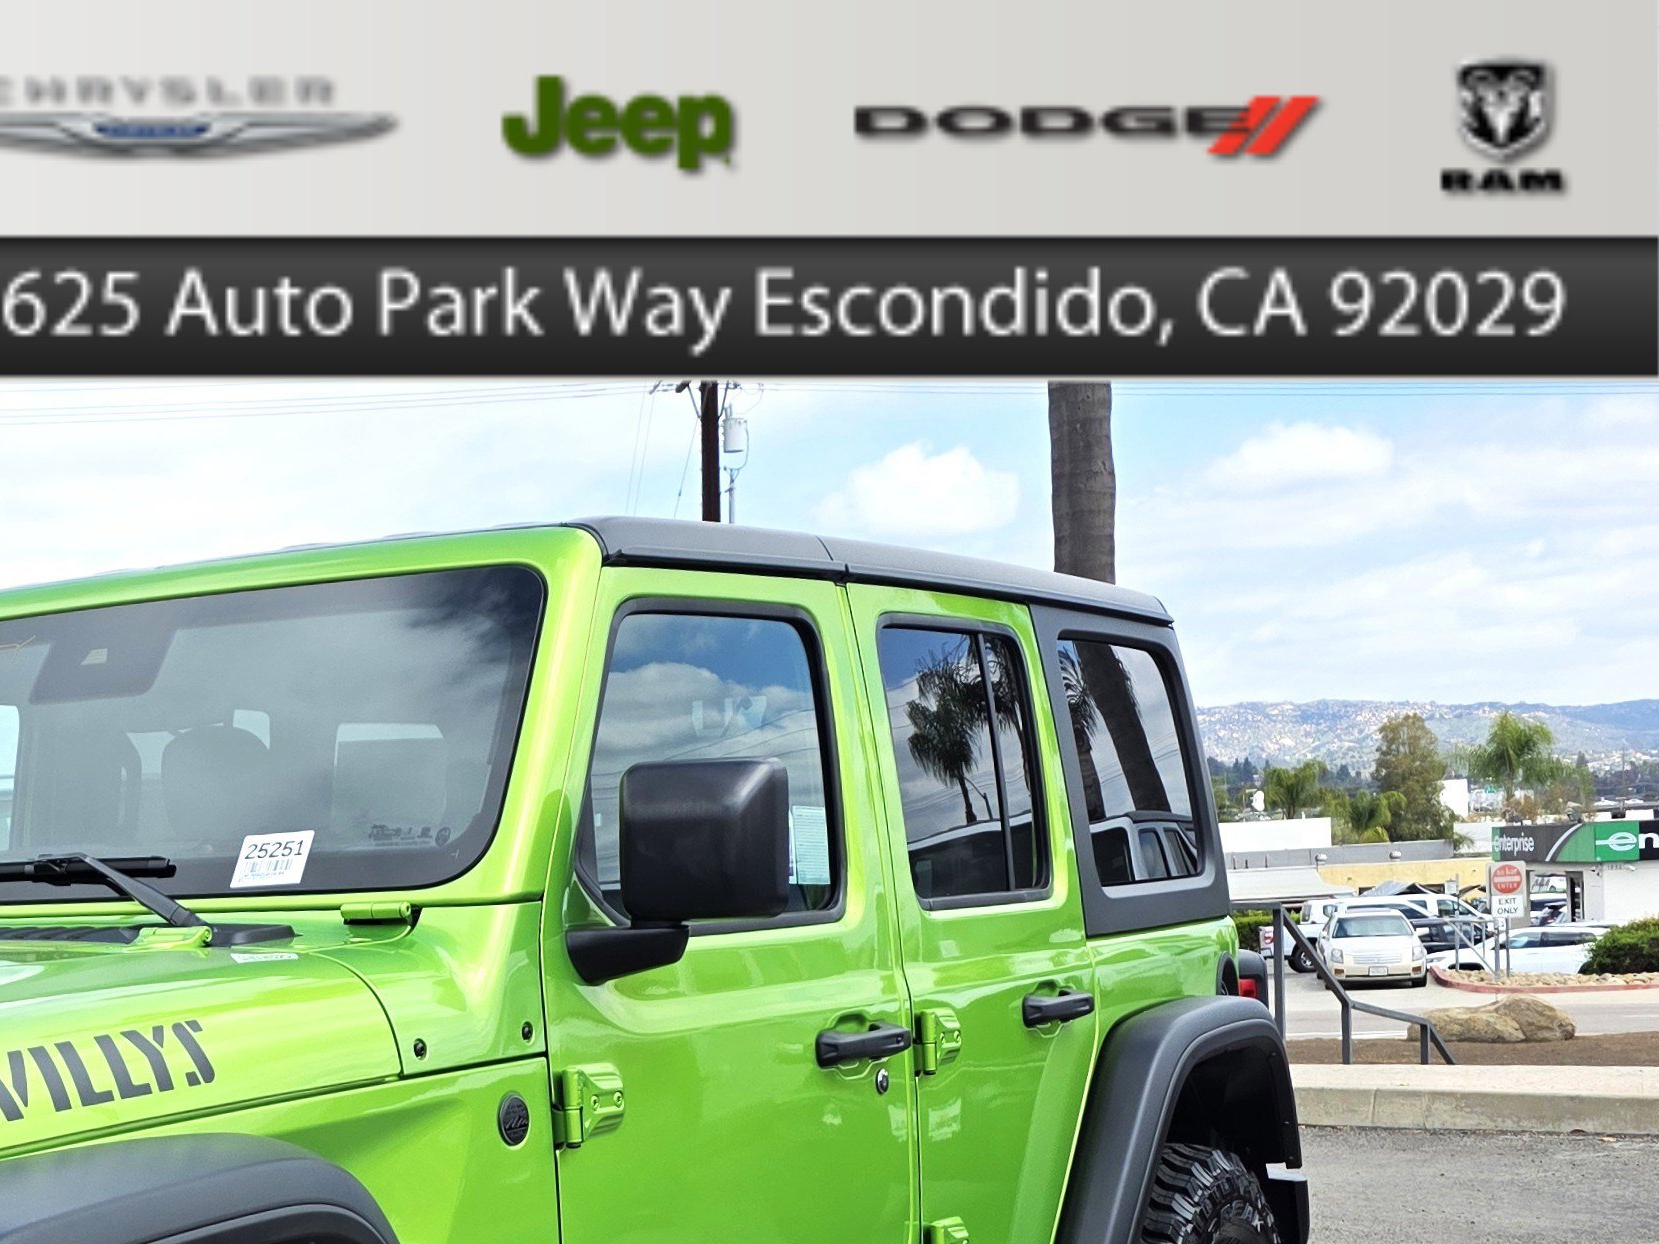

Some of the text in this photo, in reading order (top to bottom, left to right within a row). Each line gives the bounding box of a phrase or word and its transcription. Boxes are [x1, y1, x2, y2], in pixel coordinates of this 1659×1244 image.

[245, 840, 304, 860] 25251
[1492, 832, 1535, 857] enterprise
[1498, 897, 1517, 906] EXIT
[1496, 906, 1519, 915] ONLY
